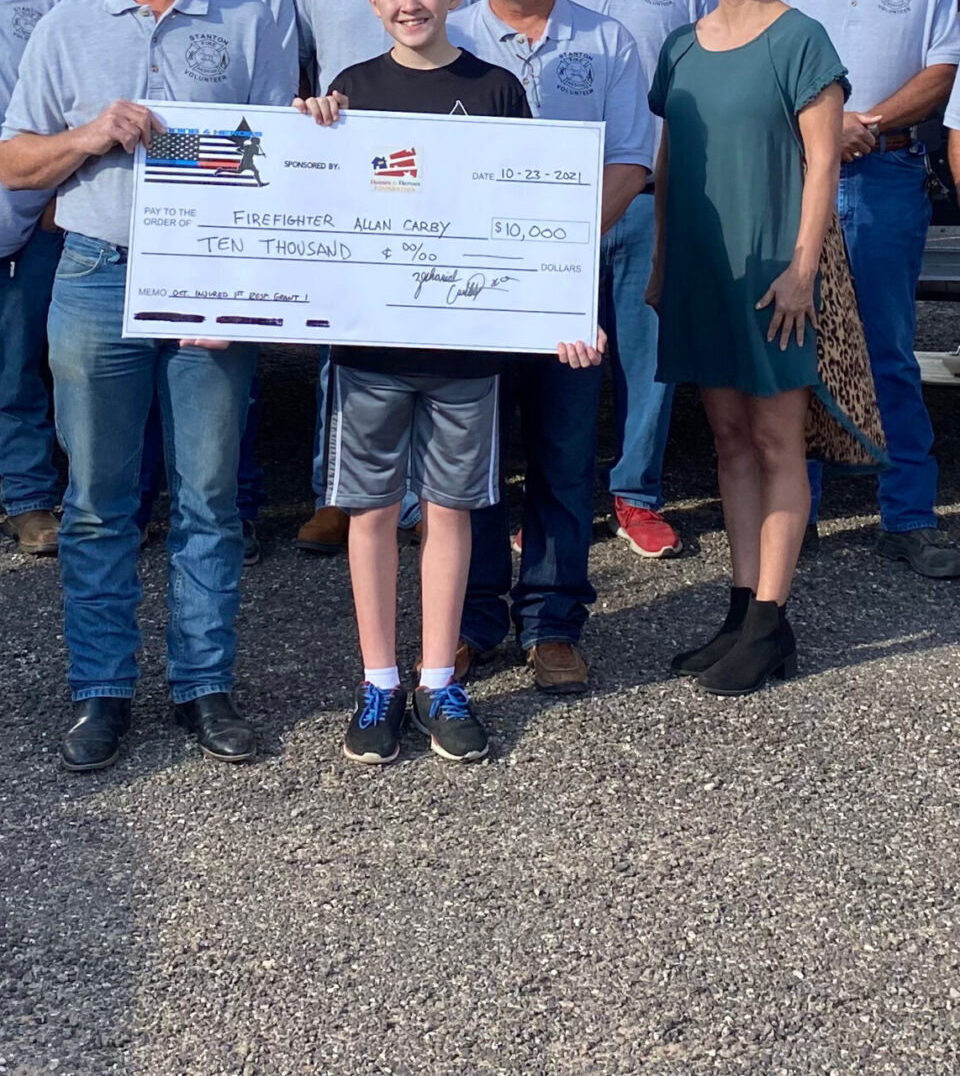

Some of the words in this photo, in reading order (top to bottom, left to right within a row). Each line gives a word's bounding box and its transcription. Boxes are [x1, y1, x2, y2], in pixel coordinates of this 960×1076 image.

[189, 33, 229, 45] STANTON
[559, 52, 593, 61] STANTON
[184, 69, 227, 83] VOLUNTEER
[556, 84, 594, 96] VOLUNTEER
[284, 160, 326, 170] SPONSORED
[472, 172, 494, 181] DATE
[144, 207, 162, 216] PAY
[164, 208, 176, 217] TO
[178, 208, 197, 217] THE
[144, 218, 177, 227] ORDER
[179, 219, 192, 228] OF
[233, 210, 335, 228] FIREFIGHTER
[353, 218, 392, 231] ALLAN
[402, 219, 451, 239] CARBY
[197, 236, 244, 253] TEN
[259, 238, 352, 260] THOUSAND
[541, 263, 581, 273] DOLLARS
[138, 288, 167, 297] MEMO
[195, 290, 228, 299] INJURED
